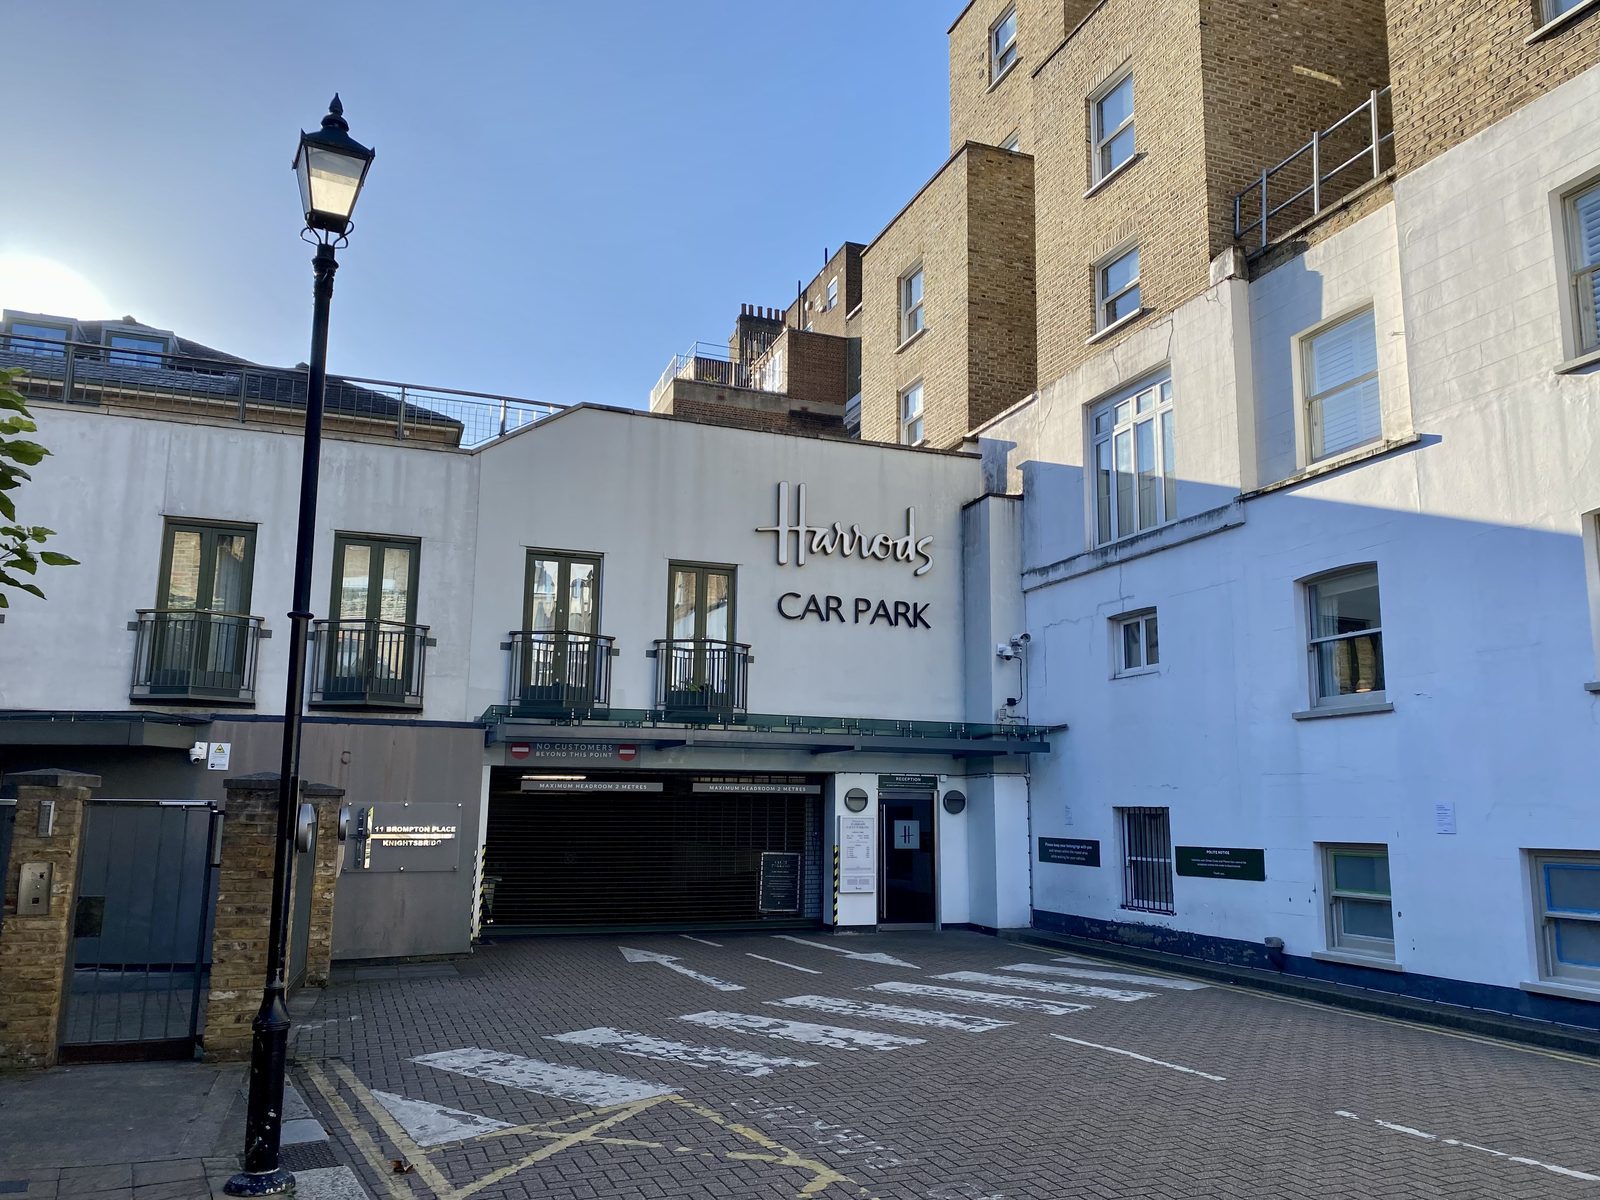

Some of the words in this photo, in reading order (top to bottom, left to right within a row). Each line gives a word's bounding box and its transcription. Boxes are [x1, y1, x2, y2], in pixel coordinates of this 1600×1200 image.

[755, 481, 934, 577] Harrods
[777, 592, 845, 623] CAR
[854, 597, 932, 629] PARK
[554, 743, 613, 751] CUSTOMERS
[382, 839, 444, 847] KNIGHTSBRIDG
